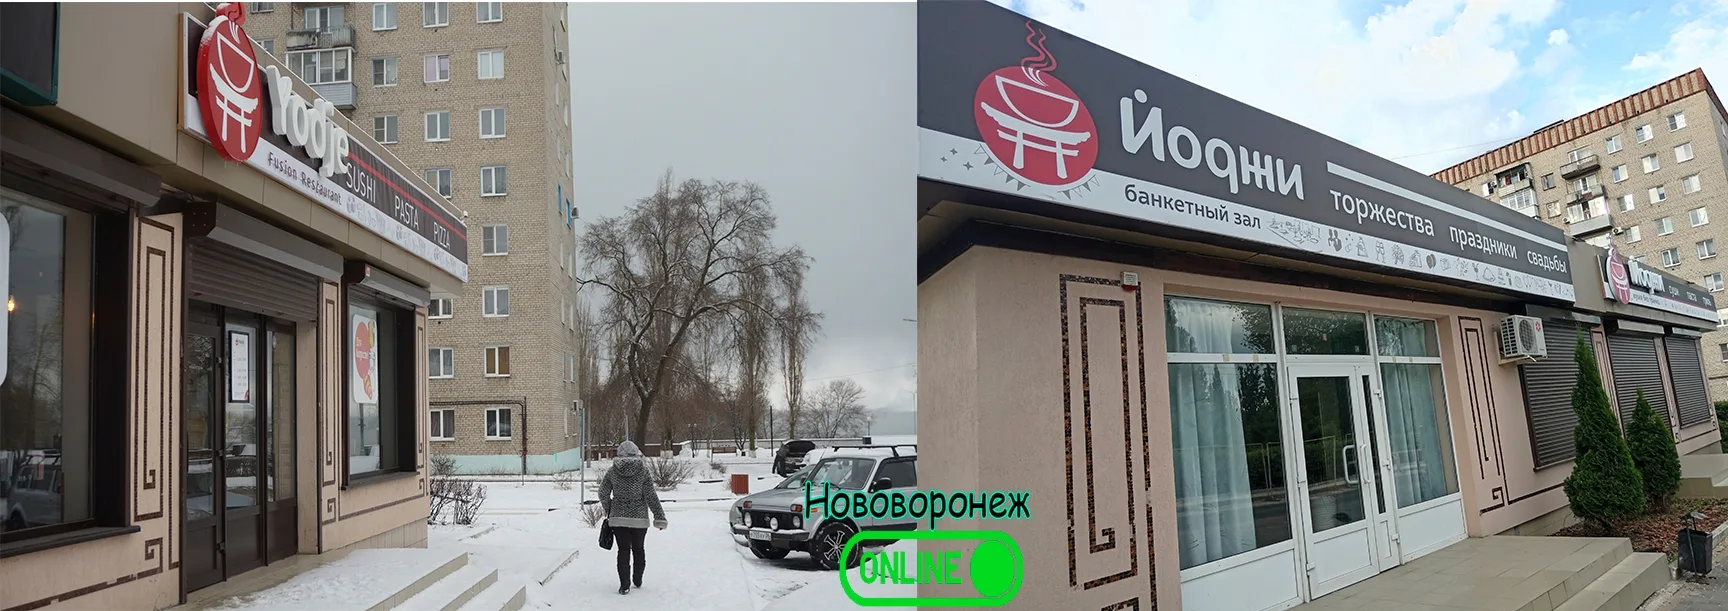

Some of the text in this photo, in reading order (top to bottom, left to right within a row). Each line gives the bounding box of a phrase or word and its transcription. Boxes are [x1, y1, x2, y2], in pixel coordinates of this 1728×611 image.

[267, 152, 342, 206] Fusion Restaurant
[1120, 88, 1305, 200] Йоджи
[346, 162, 451, 251] SUSHI PASTA PIZZA
[1124, 184, 1261, 229] банкетный зал
[1329, 189, 1568, 274] торжества праздники свадьбы
